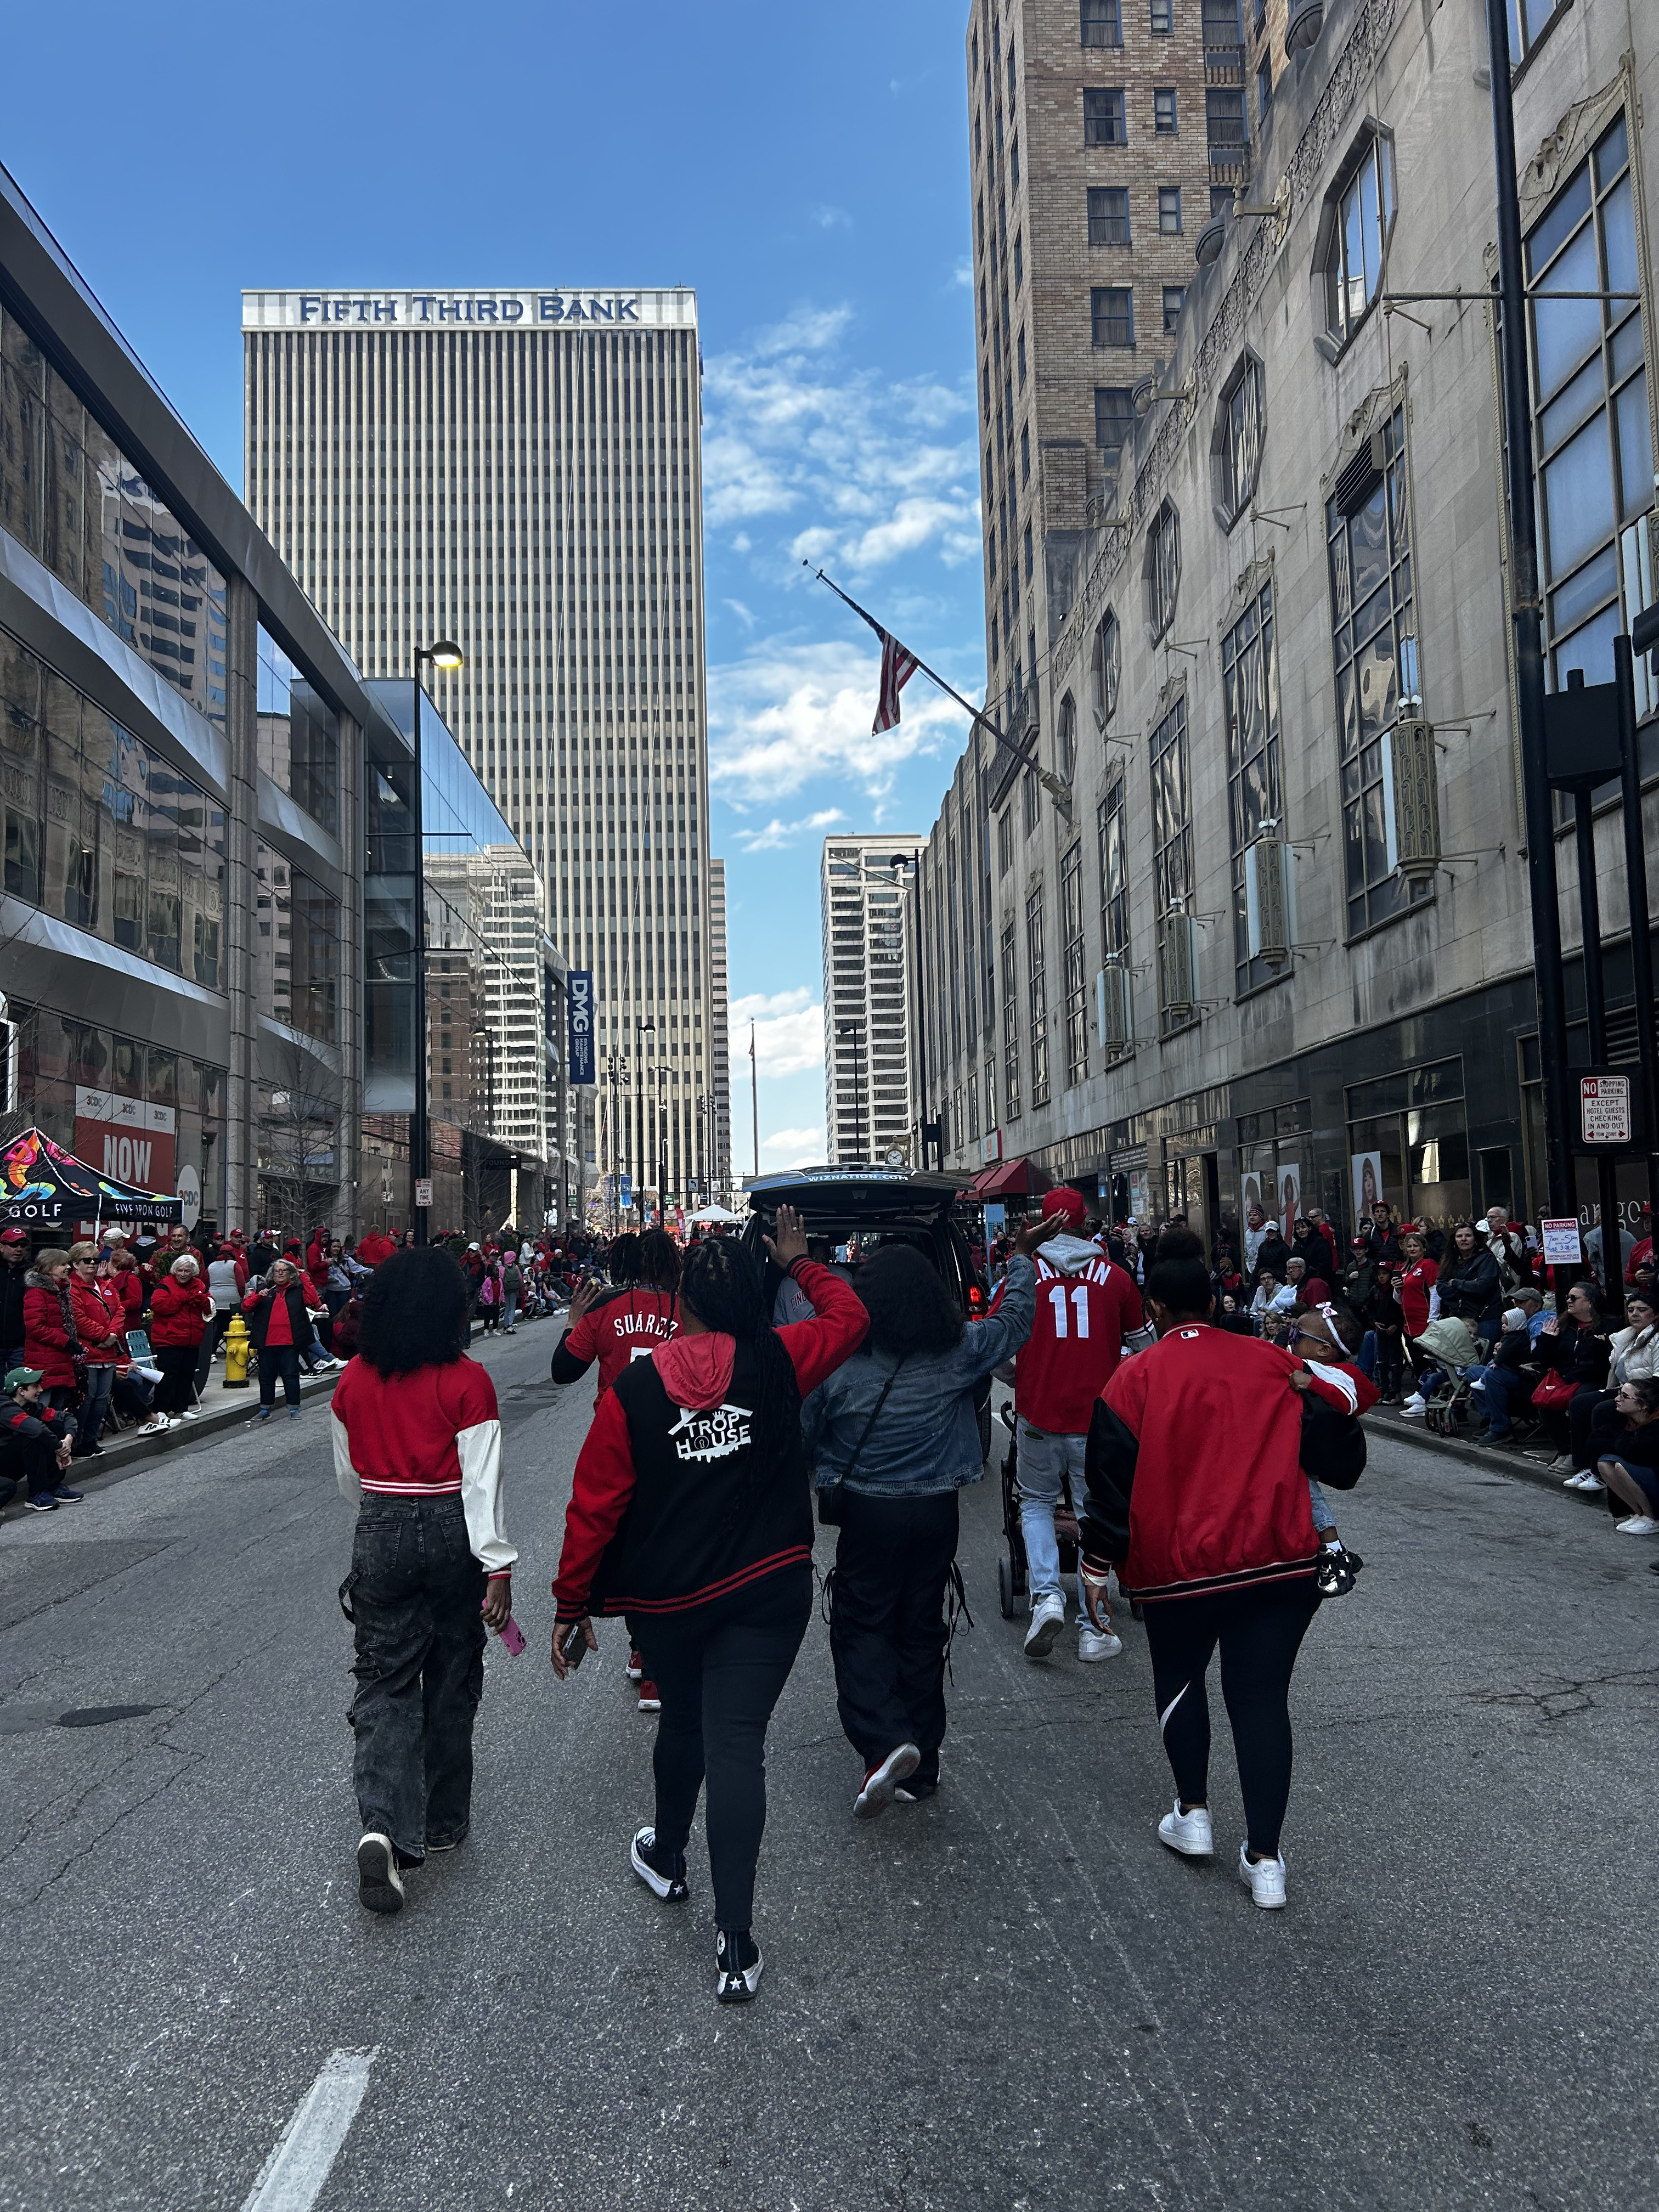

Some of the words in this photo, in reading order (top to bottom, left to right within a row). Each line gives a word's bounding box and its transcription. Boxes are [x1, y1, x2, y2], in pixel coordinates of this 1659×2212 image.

[300, 297, 397, 321] FIFTH
[413, 297, 523, 321] THIRD
[539, 296, 639, 320] BANK
[572, 979, 589, 1033] DMG
[1583, 1082, 1596, 1094] NO
[86, 1095, 102, 1108] 3CDC
[122, 1103, 136, 1115] 3CDC
[154, 1110, 167, 1121] 3CDC
[104, 1134, 152, 1183] NOW
[808, 1173, 909, 1182] WIZNATION.COM
[9, 1204, 63, 1217] GOLF
[115, 1203, 133, 1216] FIVE
[136, 1204, 153, 1216] IRON
[155, 1205, 173, 1217] GOLF
[1049, 1286, 1089, 1338] 11
[684, 1412, 740, 1437] TROP
